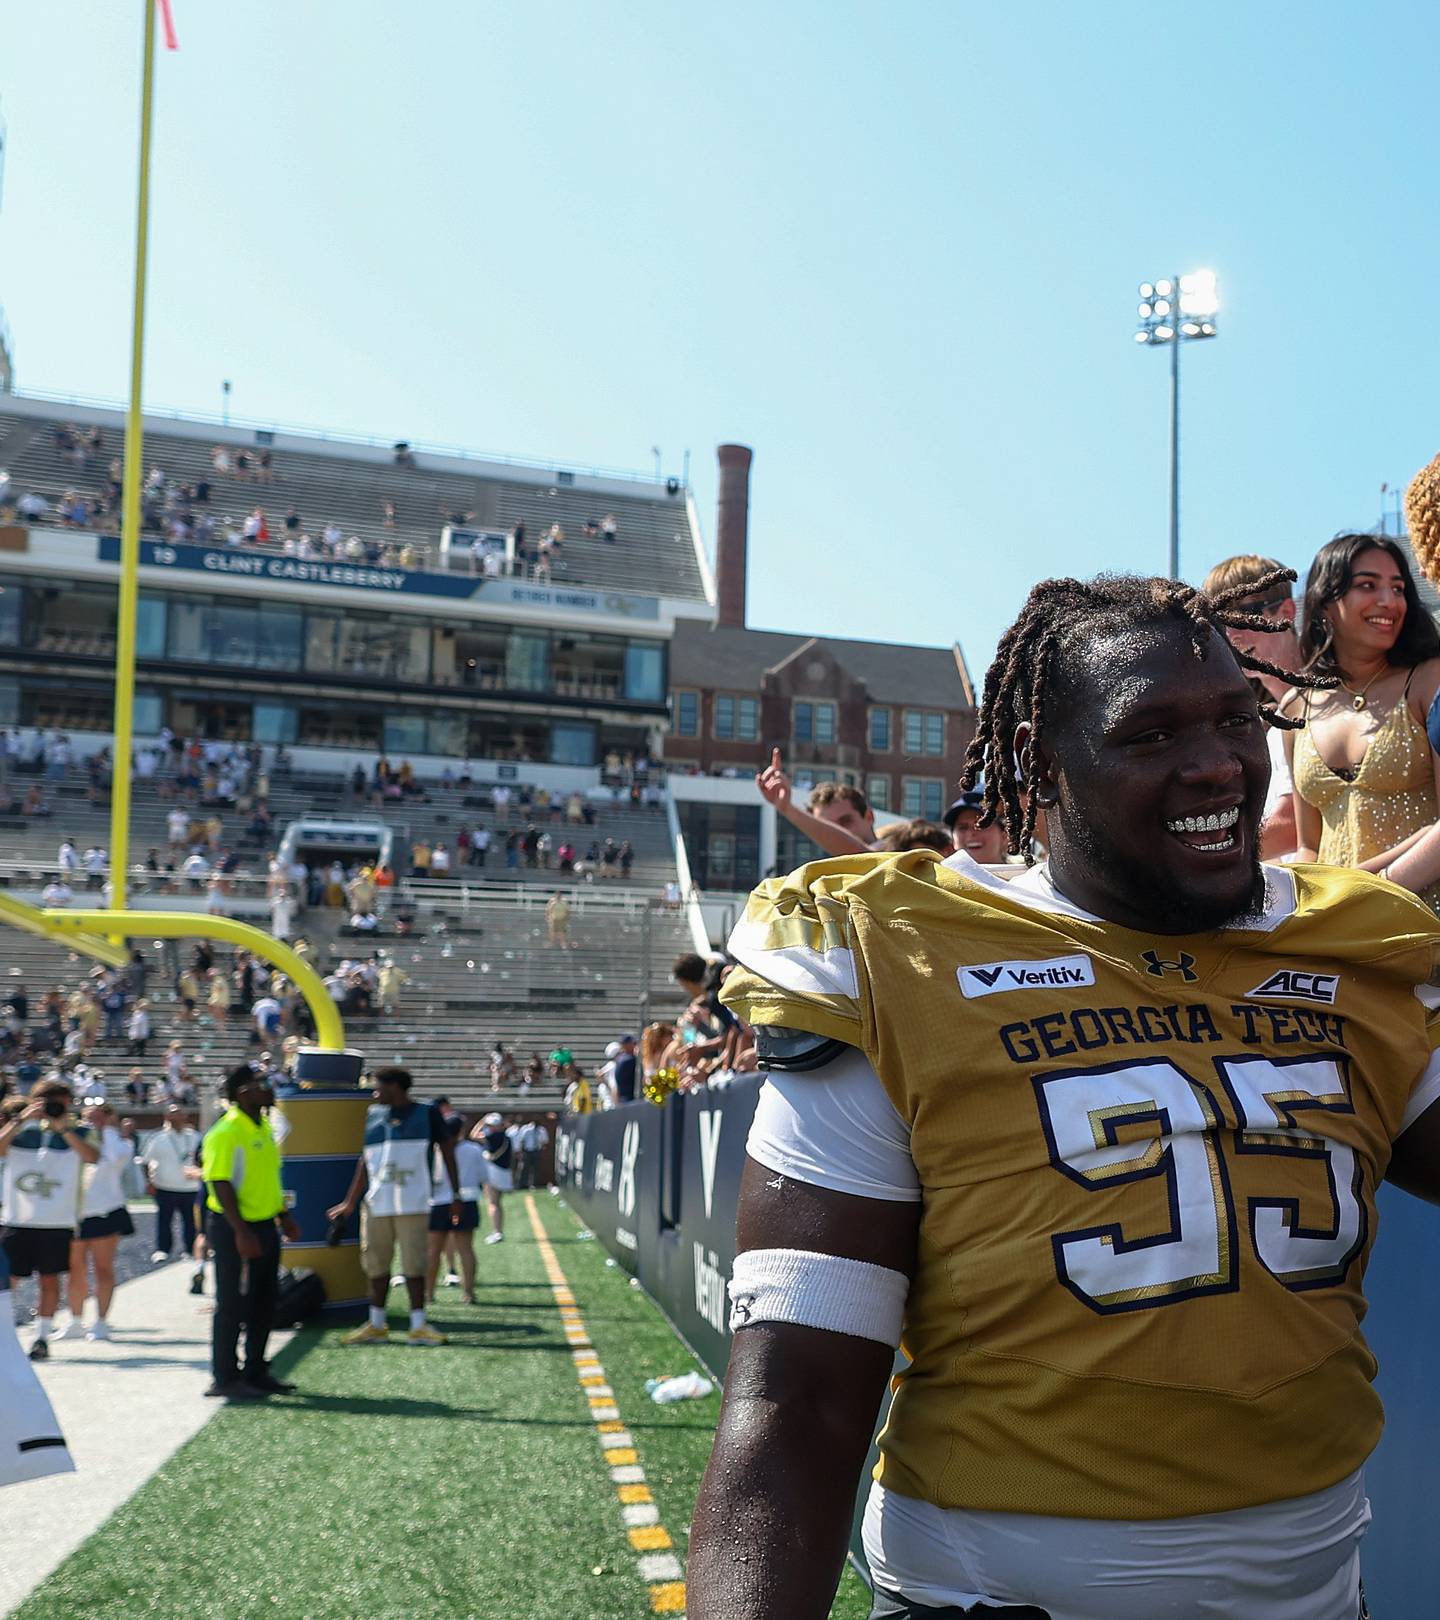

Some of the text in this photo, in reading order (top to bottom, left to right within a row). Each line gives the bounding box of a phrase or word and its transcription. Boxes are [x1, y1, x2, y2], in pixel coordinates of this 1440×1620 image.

[153, 545, 407, 590] 19 CLINT CASTLEBERRY
[1260, 973, 1337, 995] ACC
[1000, 1003, 1347, 1064] GEORGIA TECH
[1031, 1053, 1368, 1316] 95
